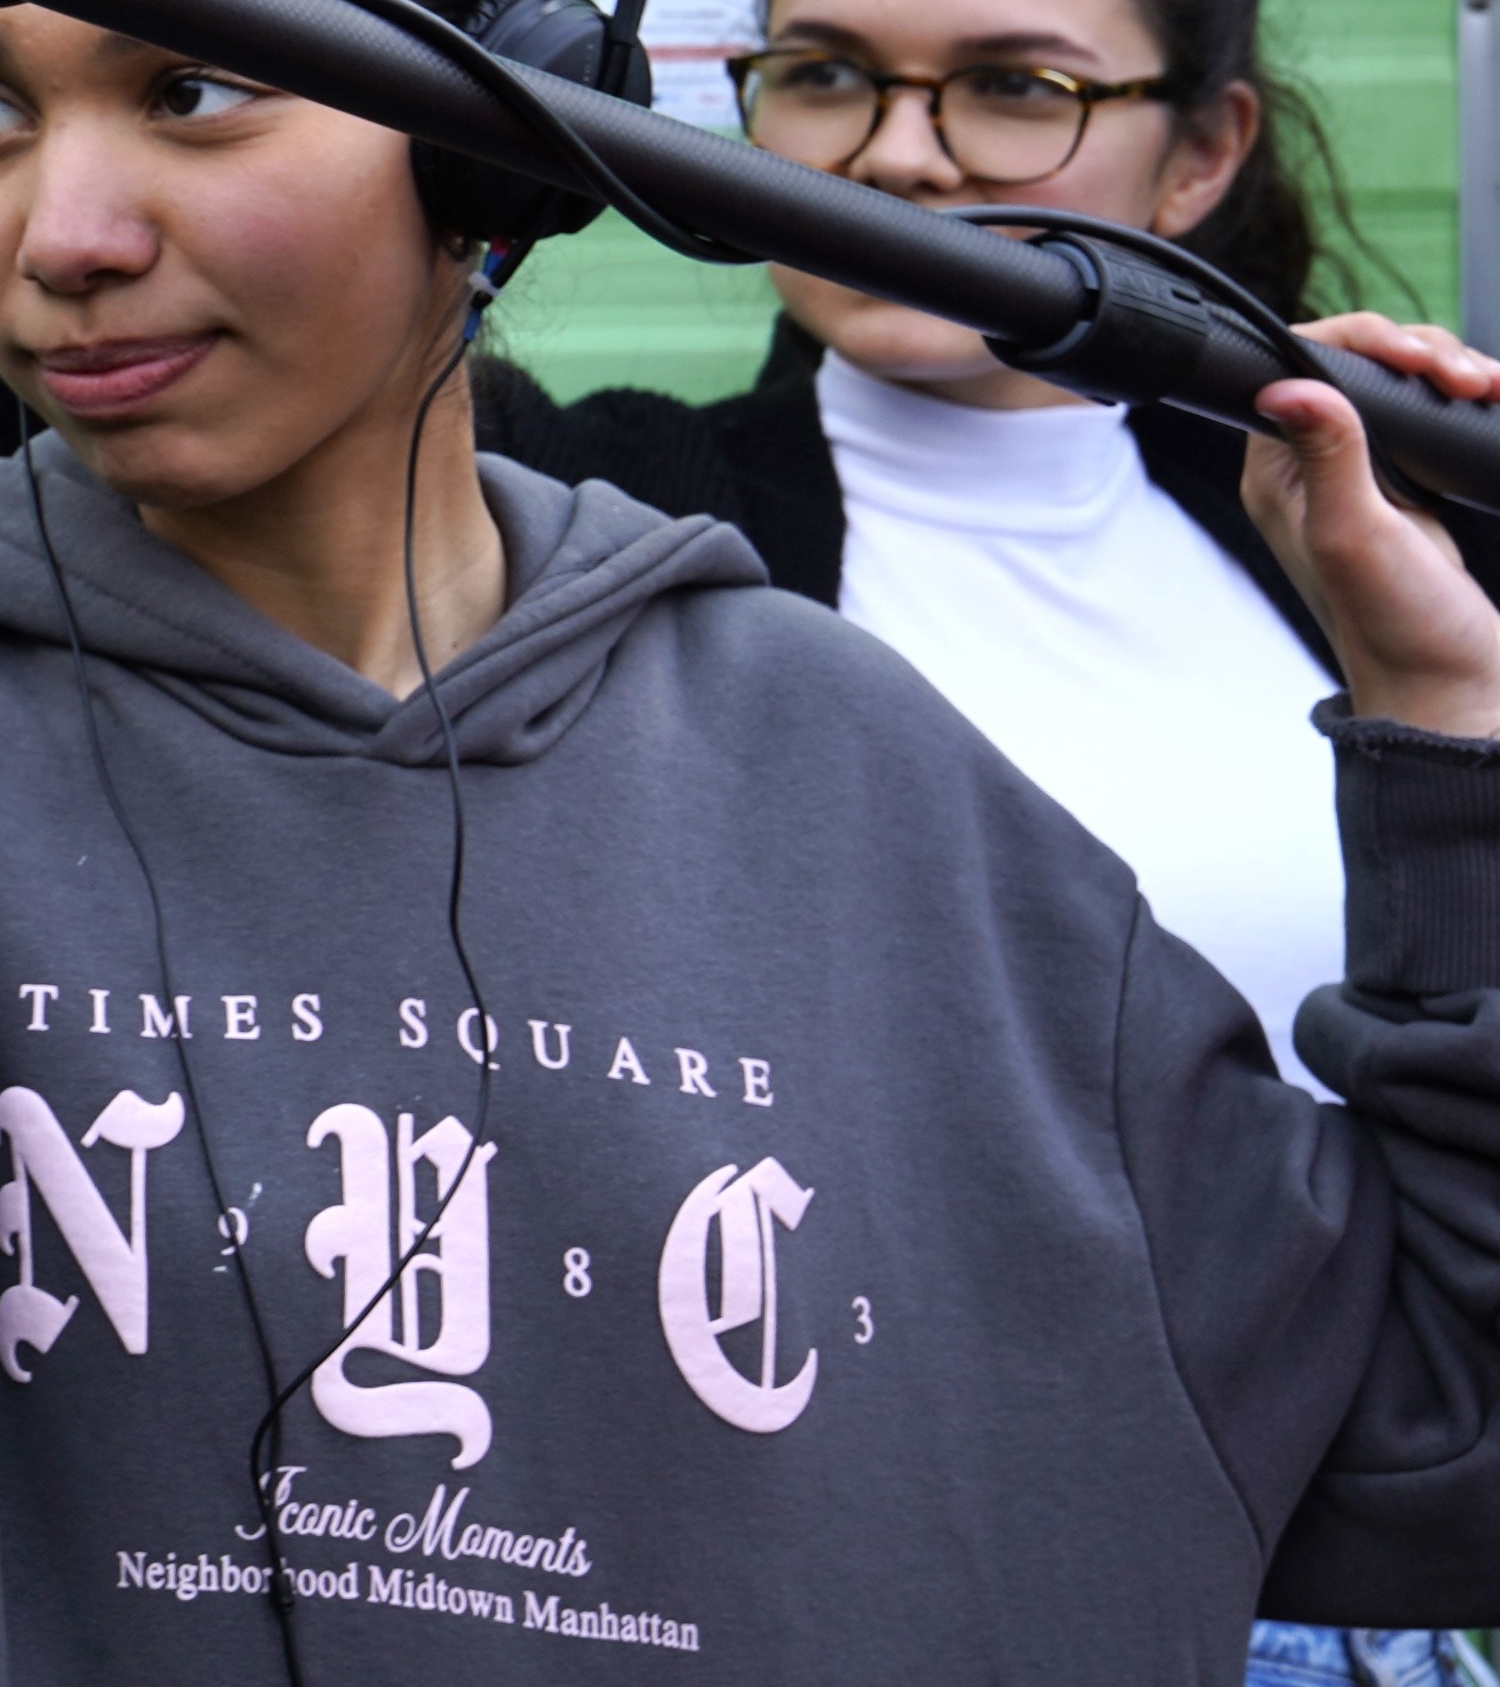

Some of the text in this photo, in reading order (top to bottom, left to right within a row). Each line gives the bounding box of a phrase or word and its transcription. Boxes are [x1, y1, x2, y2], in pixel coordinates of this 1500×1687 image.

[19, 984, 775, 1108] TIMES SQUARE
[562, 1247, 593, 1298] 8
[851, 1295, 875, 1346] 3
[235, 1465, 594, 1579] Iconic Moments
[368, 1564, 515, 1623] Midtown
[523, 1591, 701, 1652] Manhattan
